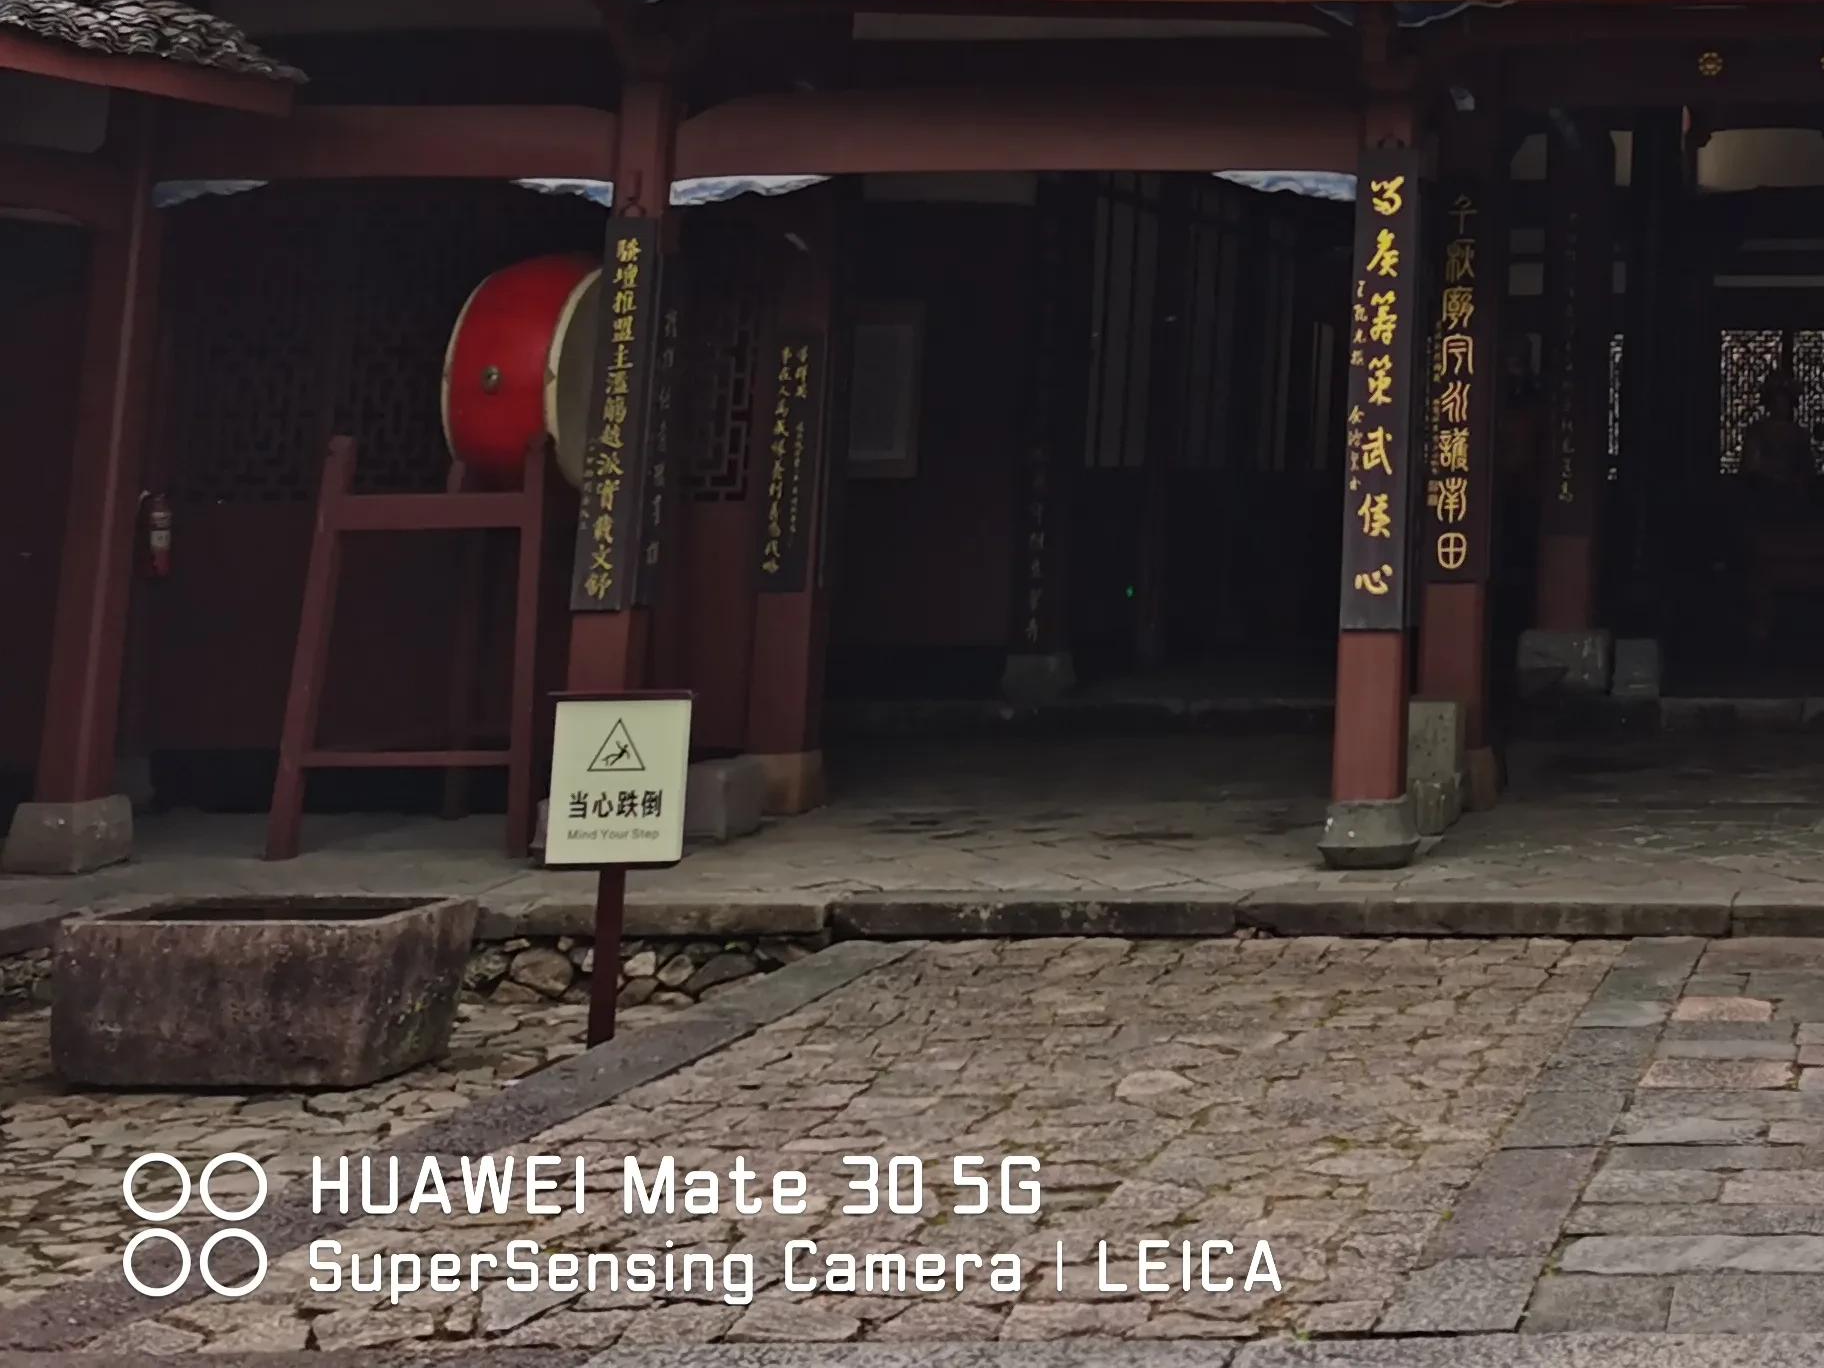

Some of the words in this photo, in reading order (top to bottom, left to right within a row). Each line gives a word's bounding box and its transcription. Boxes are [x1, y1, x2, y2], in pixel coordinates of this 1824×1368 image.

[567, 788, 664, 821] 当心跌倒
[567, 828, 597, 841] Mind
[600, 828, 629, 841] Your
[632, 827, 660, 842] Step
